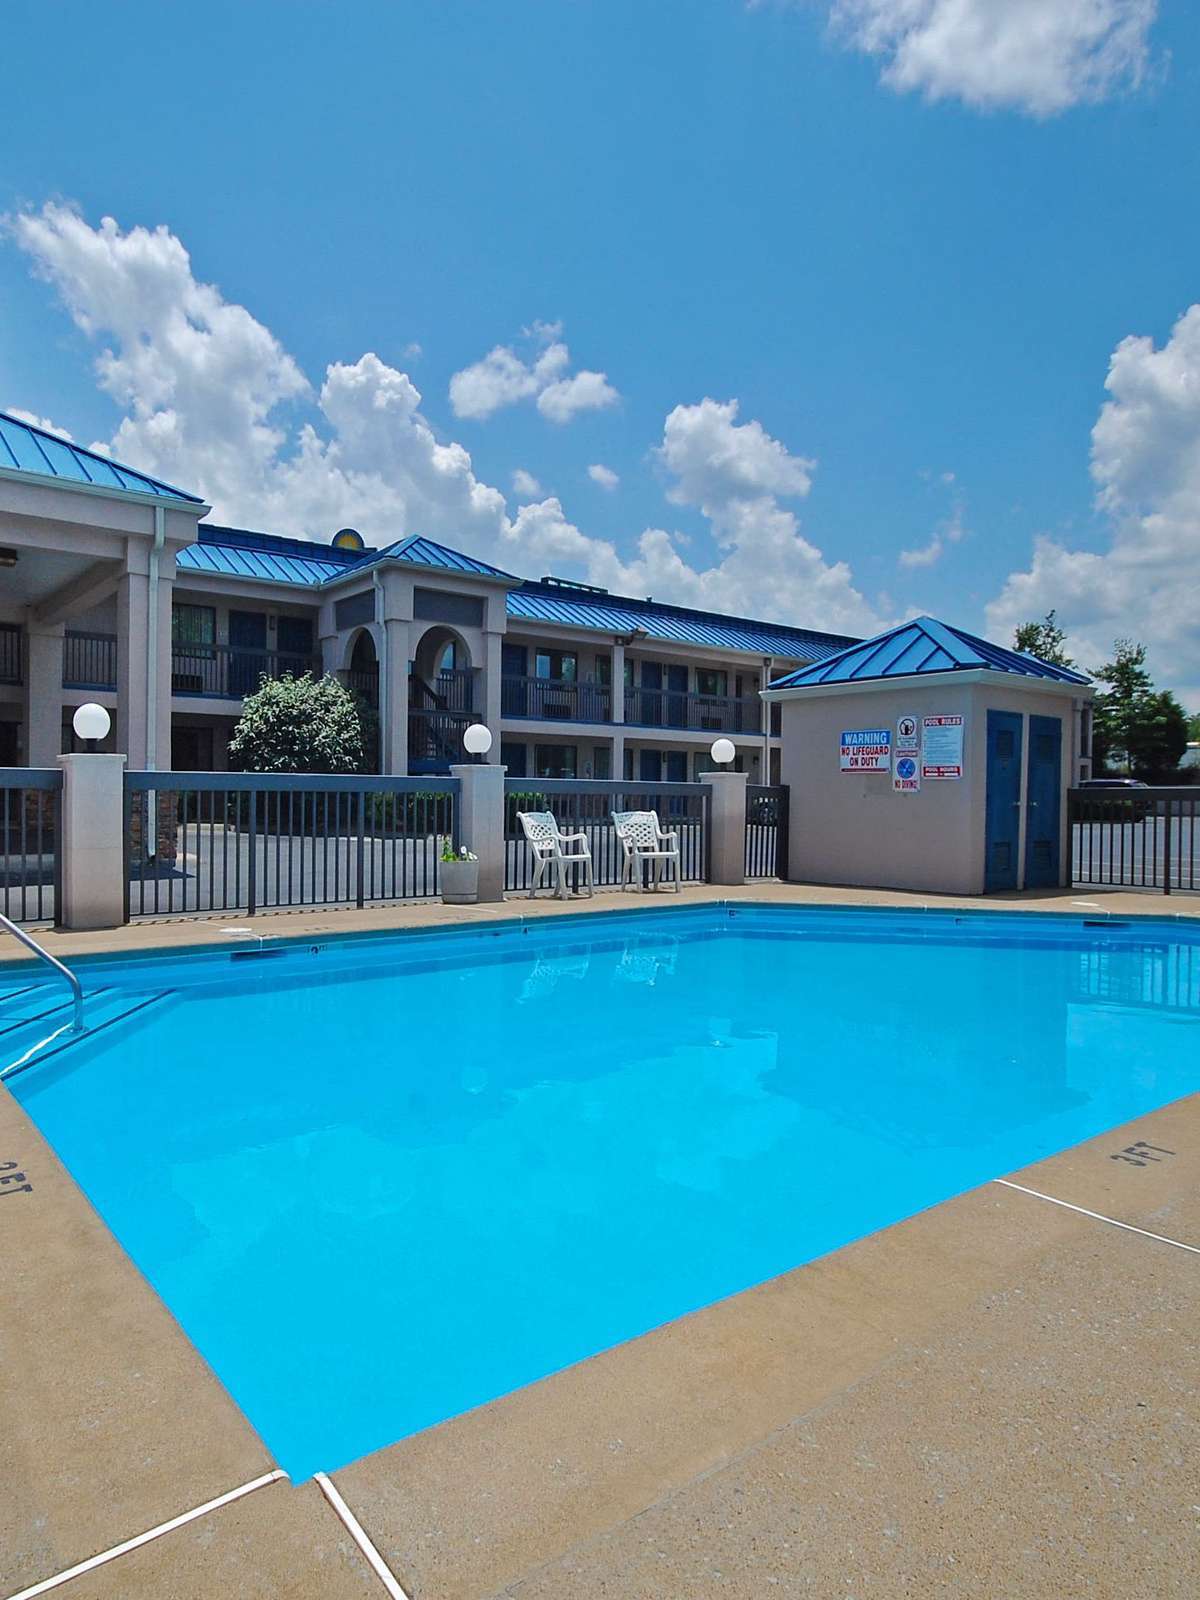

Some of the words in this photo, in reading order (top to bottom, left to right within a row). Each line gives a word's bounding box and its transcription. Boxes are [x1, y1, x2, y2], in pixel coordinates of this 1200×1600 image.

[844, 732, 887, 744] WARNING
[841, 747, 850, 756] NO
[853, 746, 889, 756] LIFEGUARD
[850, 757, 858, 766] ON
[861, 757, 879, 766] DUTY
